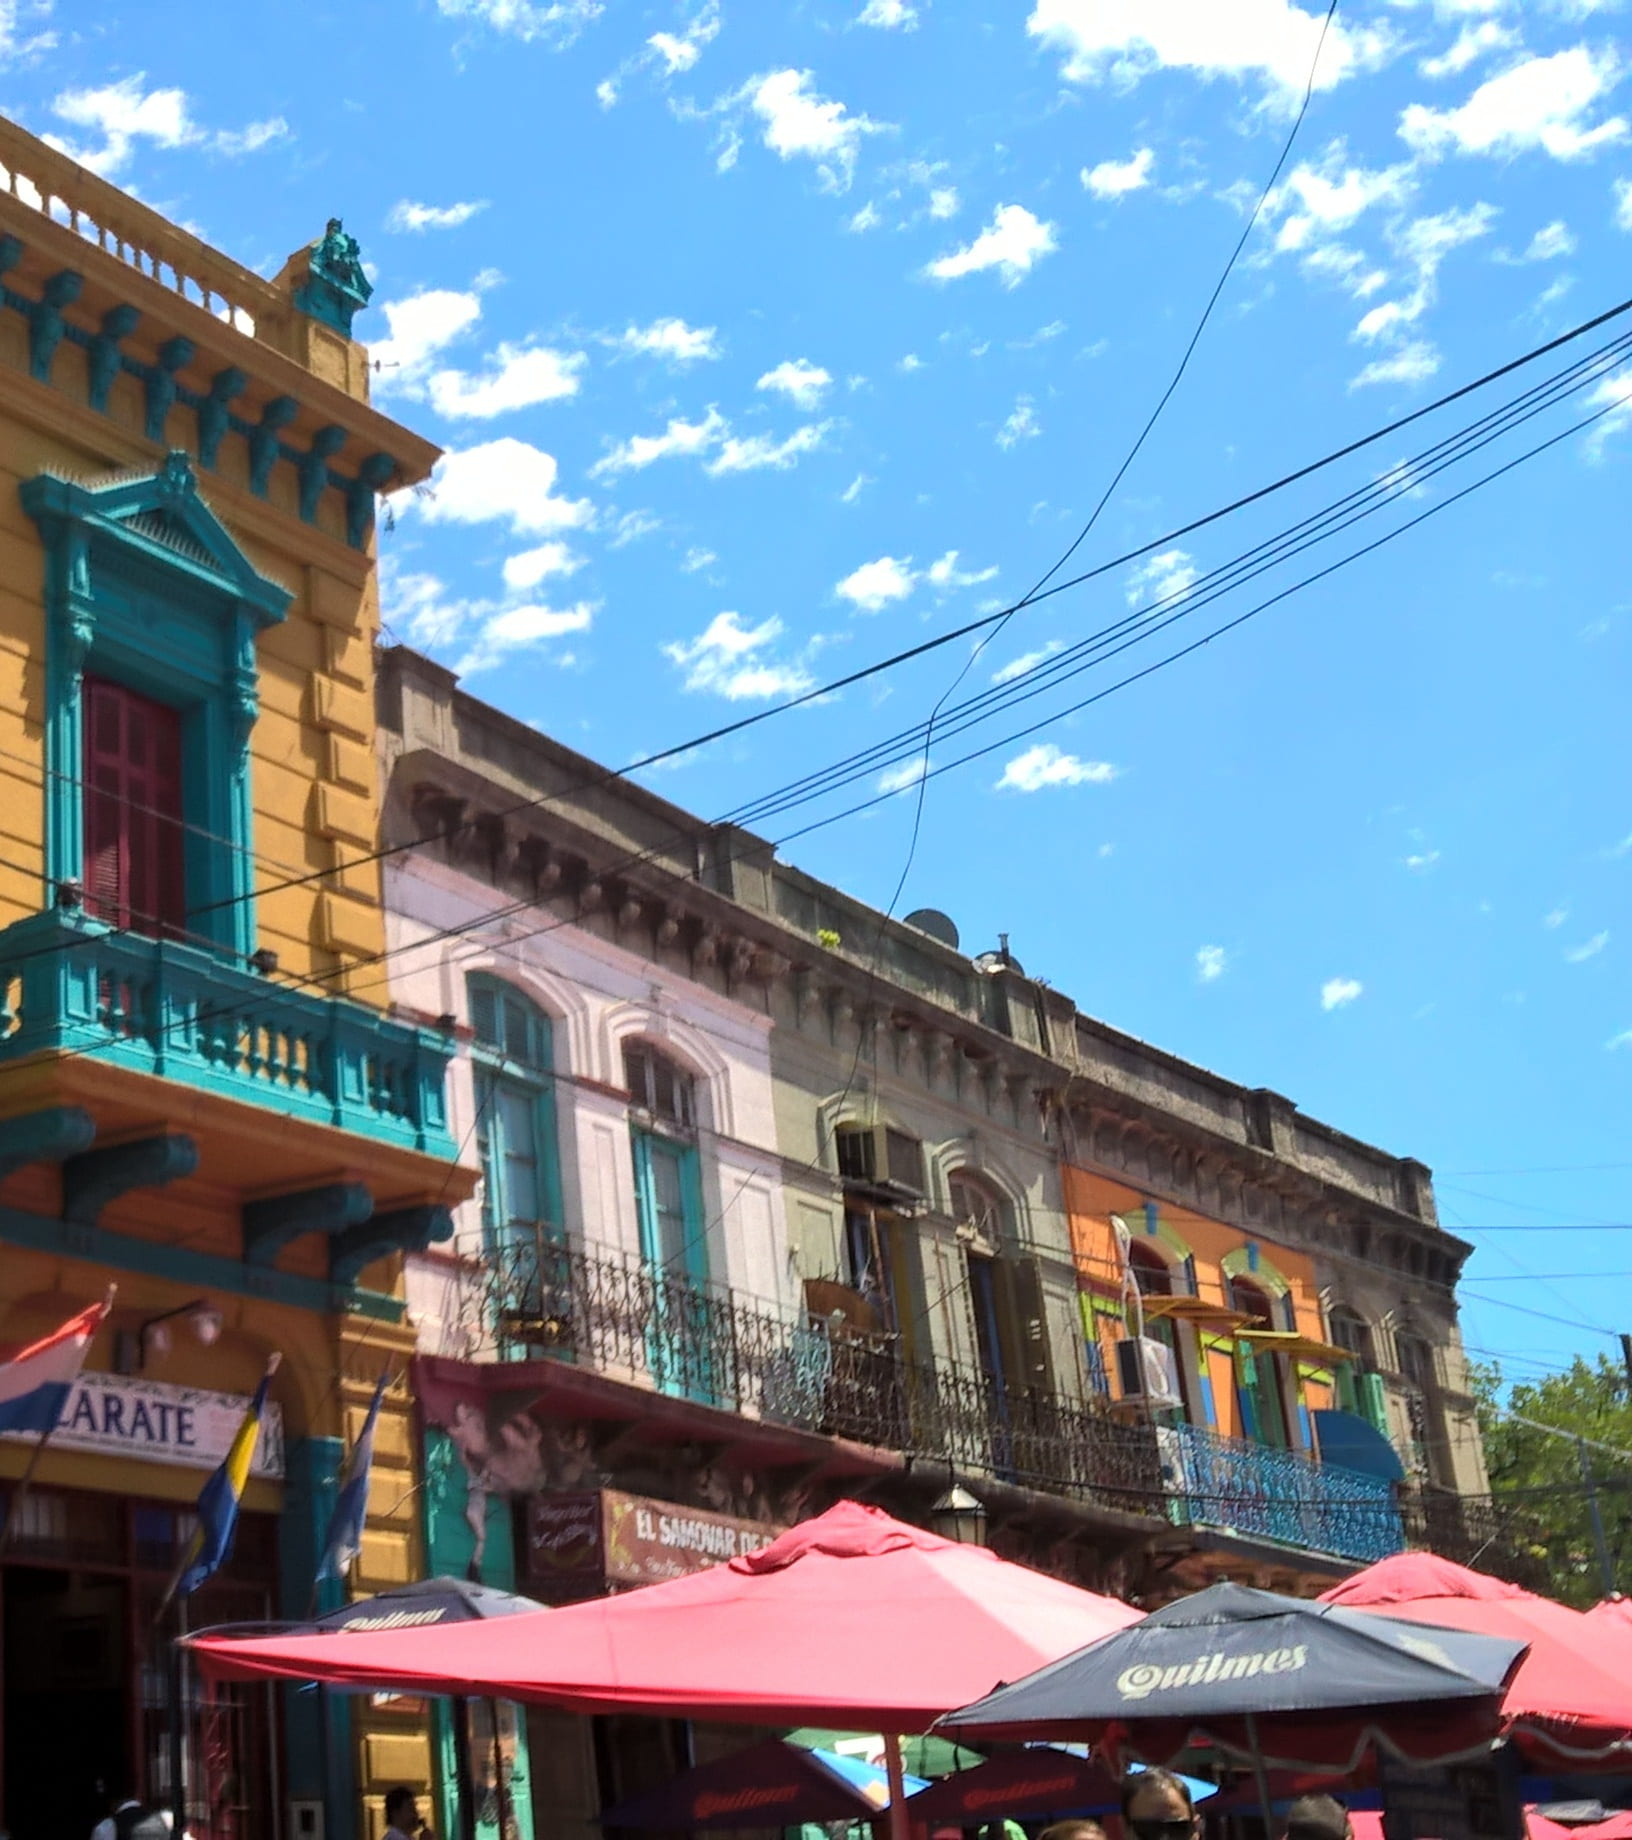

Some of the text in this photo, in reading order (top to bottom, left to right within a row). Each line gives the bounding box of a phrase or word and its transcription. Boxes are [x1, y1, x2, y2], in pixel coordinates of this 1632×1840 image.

[58, 1388, 196, 1446] ARATE
[635, 1508, 657, 1541] EL
[658, 1514, 737, 1557] SAMOVAR
[1116, 1644, 1310, 1700] Quilmes
